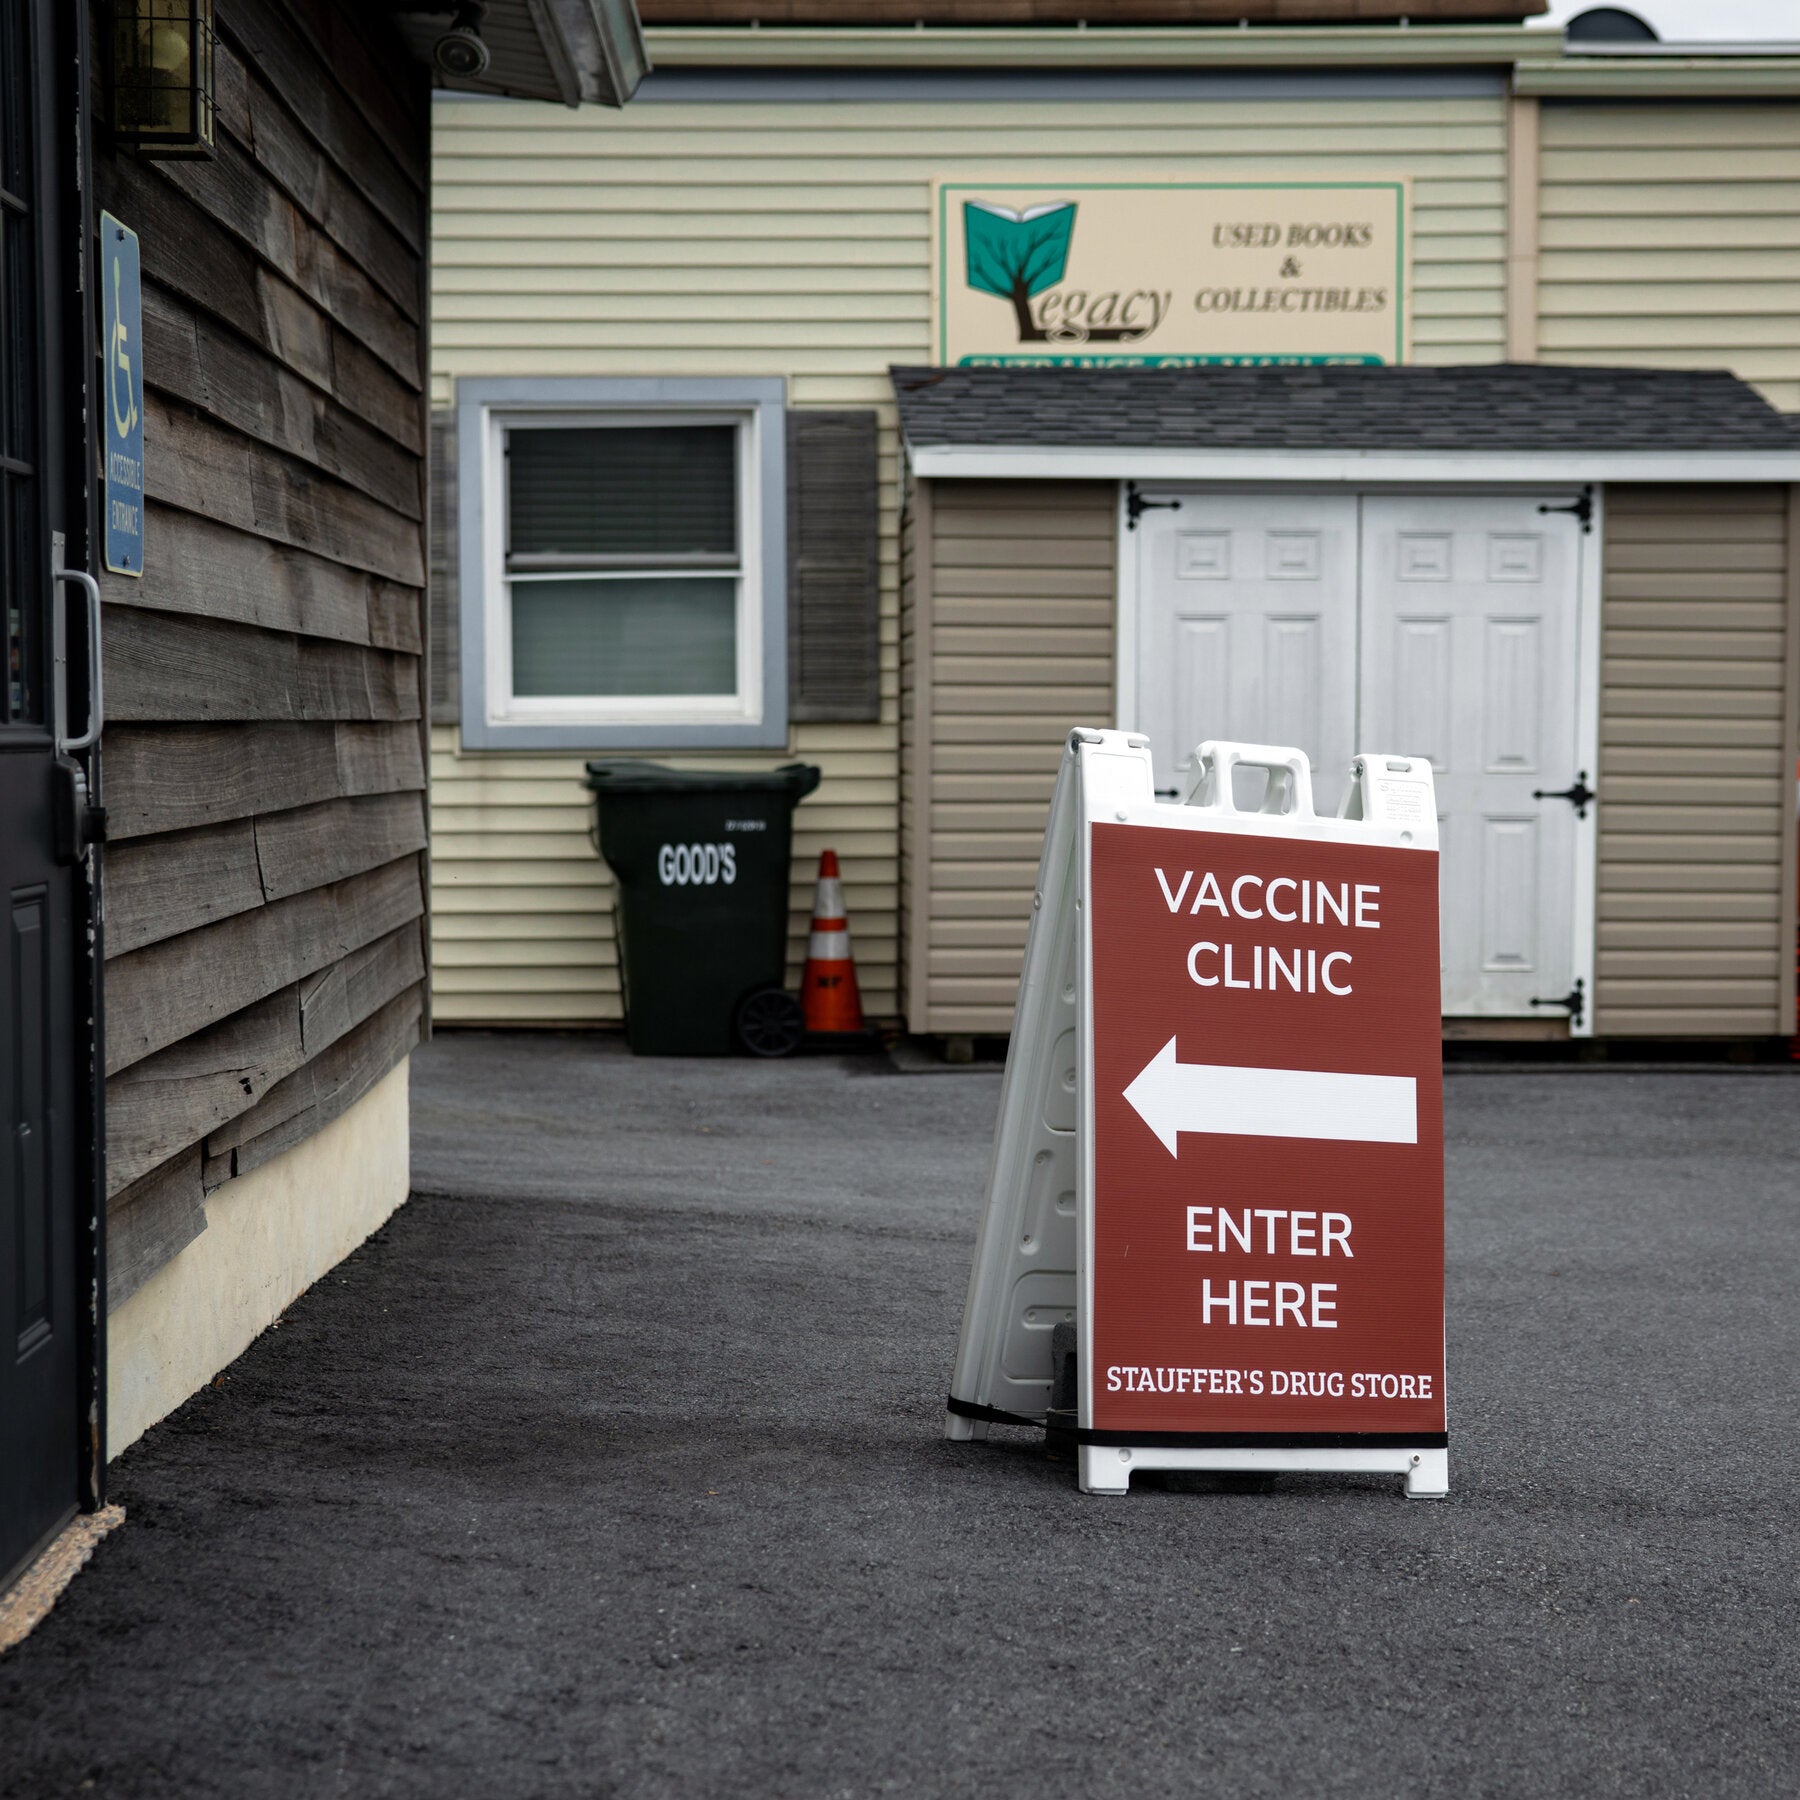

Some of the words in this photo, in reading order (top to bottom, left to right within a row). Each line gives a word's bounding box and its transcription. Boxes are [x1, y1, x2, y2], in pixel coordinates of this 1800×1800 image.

[1212, 222, 1282, 248] USED
[1286, 222, 1373, 248] BOOKS
[1279, 255, 1303, 278] &
[1194, 286, 1388, 313] COLLECTIBLES
[110, 452, 140, 490] ACCESSIBLE
[112, 500, 138, 535] ENTRANCE
[658, 842, 737, 886] GOOD'S
[1154, 868, 1381, 929] VACCINE
[1187, 941, 1353, 996] CLINIC
[1186, 1206, 1354, 1258] ENTER
[1202, 1278, 1338, 1329] HERE
[1106, 1365, 1264, 1396] STAUFFER'S
[1270, 1370, 1345, 1398] DRUG
[1350, 1373, 1433, 1400] STORE
